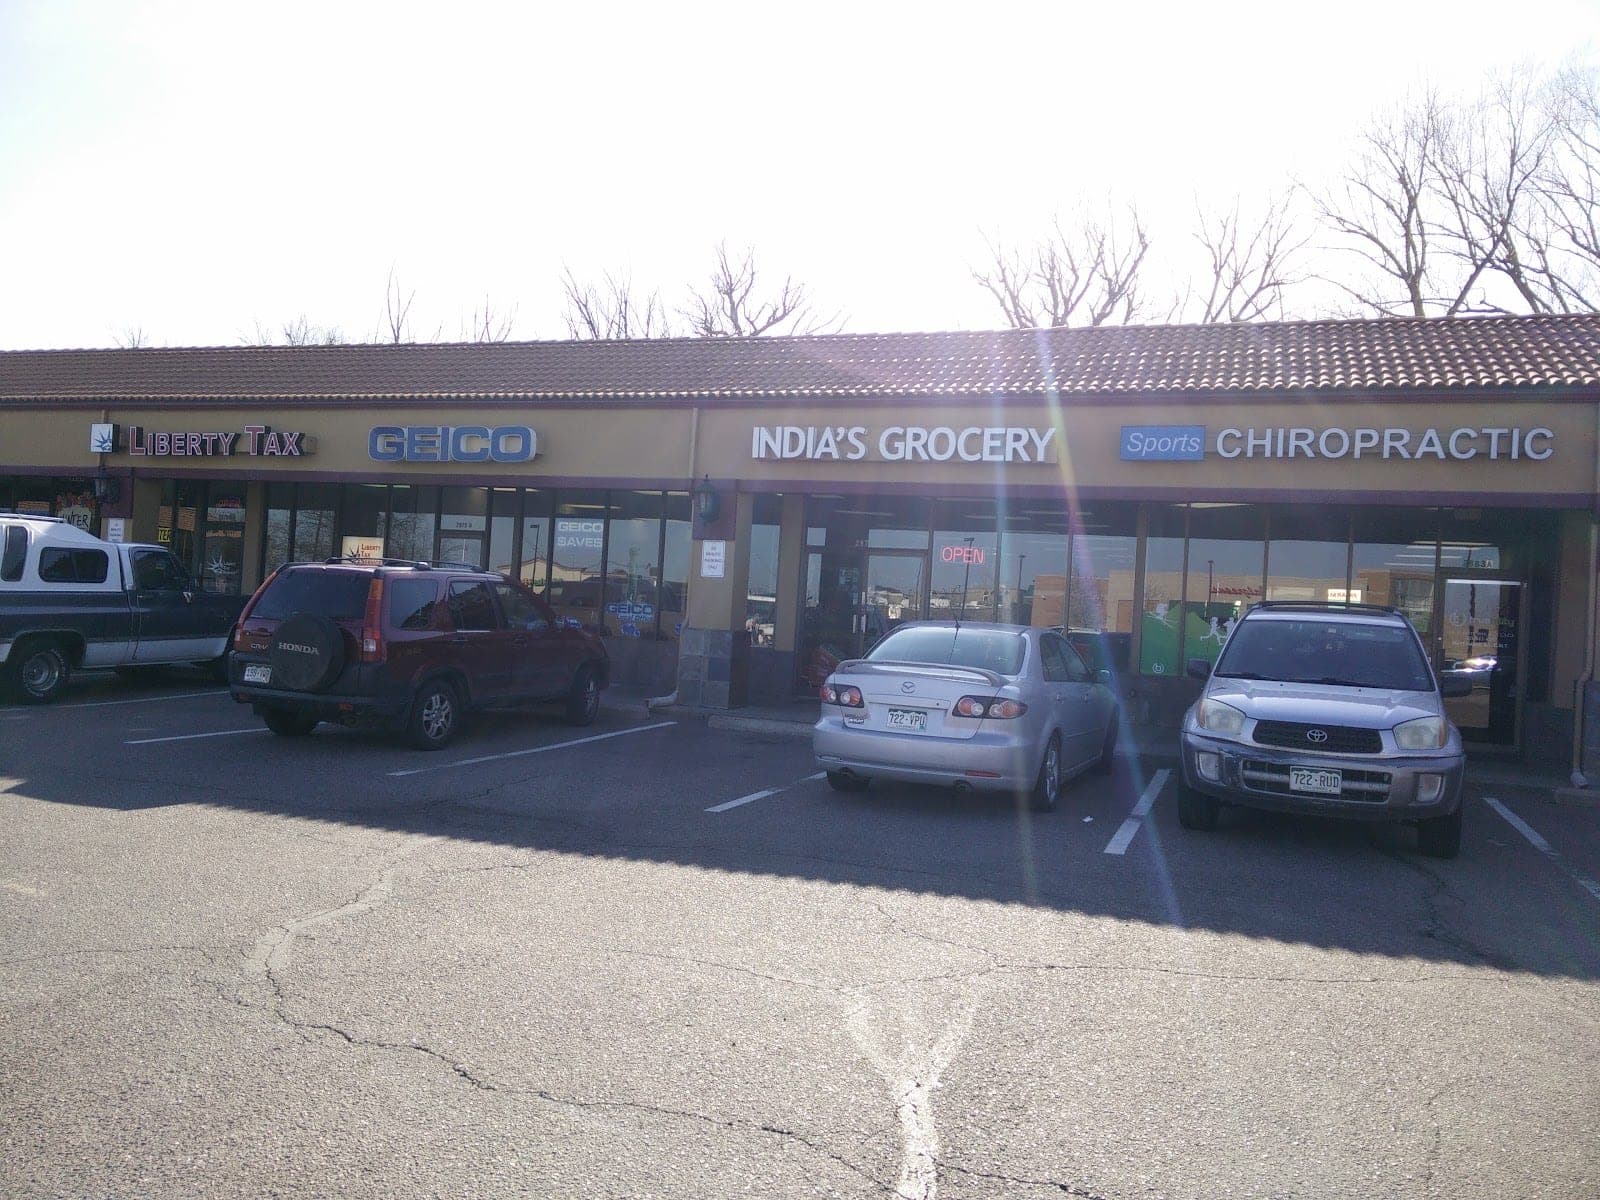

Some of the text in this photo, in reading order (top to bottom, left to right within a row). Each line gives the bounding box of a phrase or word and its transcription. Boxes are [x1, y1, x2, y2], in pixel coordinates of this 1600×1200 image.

[129, 425, 302, 455] LIBERTY TAX
[368, 425, 537, 462] GEICO
[752, 426, 1056, 462] INDIA'S GROCERY
[1126, 432, 1201, 454] Sports
[1216, 427, 1554, 460] CHIROPRACTIC
[558, 521, 603, 532] GEICO
[557, 536, 603, 547] SAVES
[941, 546, 985, 564] OPEN
[607, 602, 653, 614] GEICO
[279, 642, 319, 655] HONDA
